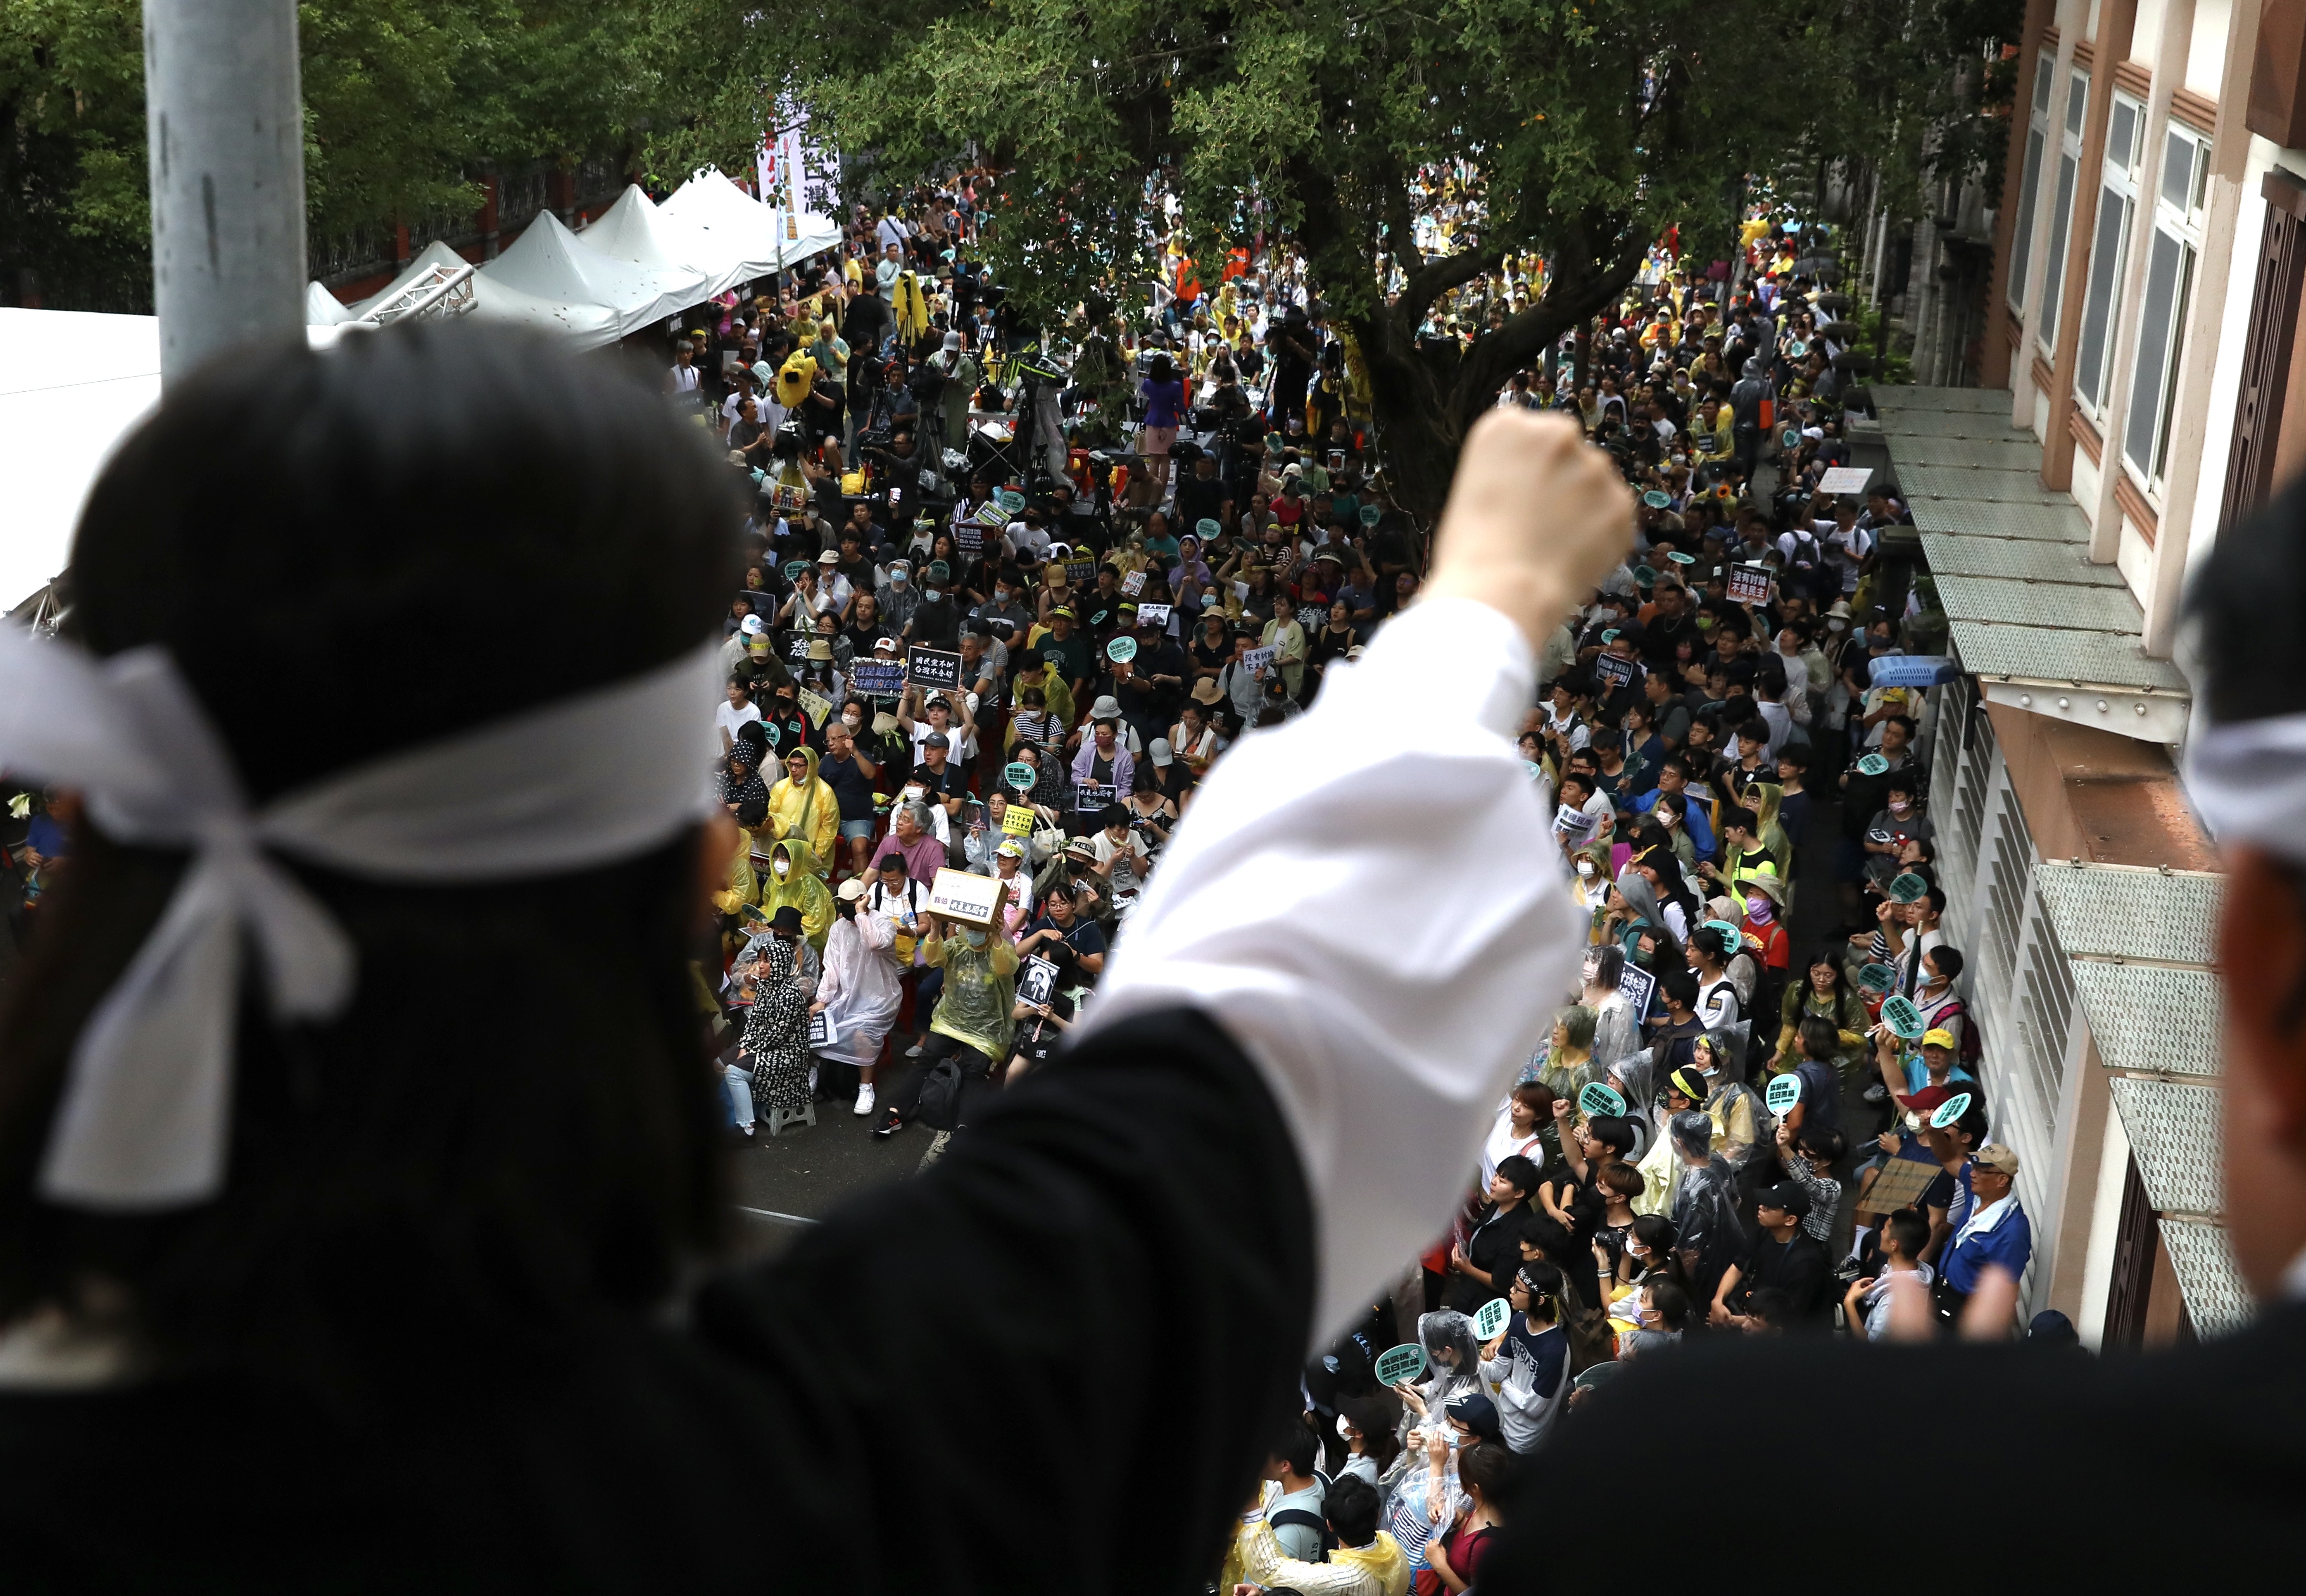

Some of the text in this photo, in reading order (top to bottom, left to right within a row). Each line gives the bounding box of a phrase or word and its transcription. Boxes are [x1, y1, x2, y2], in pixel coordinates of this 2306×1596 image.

[1733, 571, 1766, 586] 沒有討論
[1731, 583, 1765, 598] 不是民主
[916, 656, 954, 670] 國民黨不倒
[856, 666, 905, 676] 我是追星人
[915, 665, 953, 678] 台灣不會好
